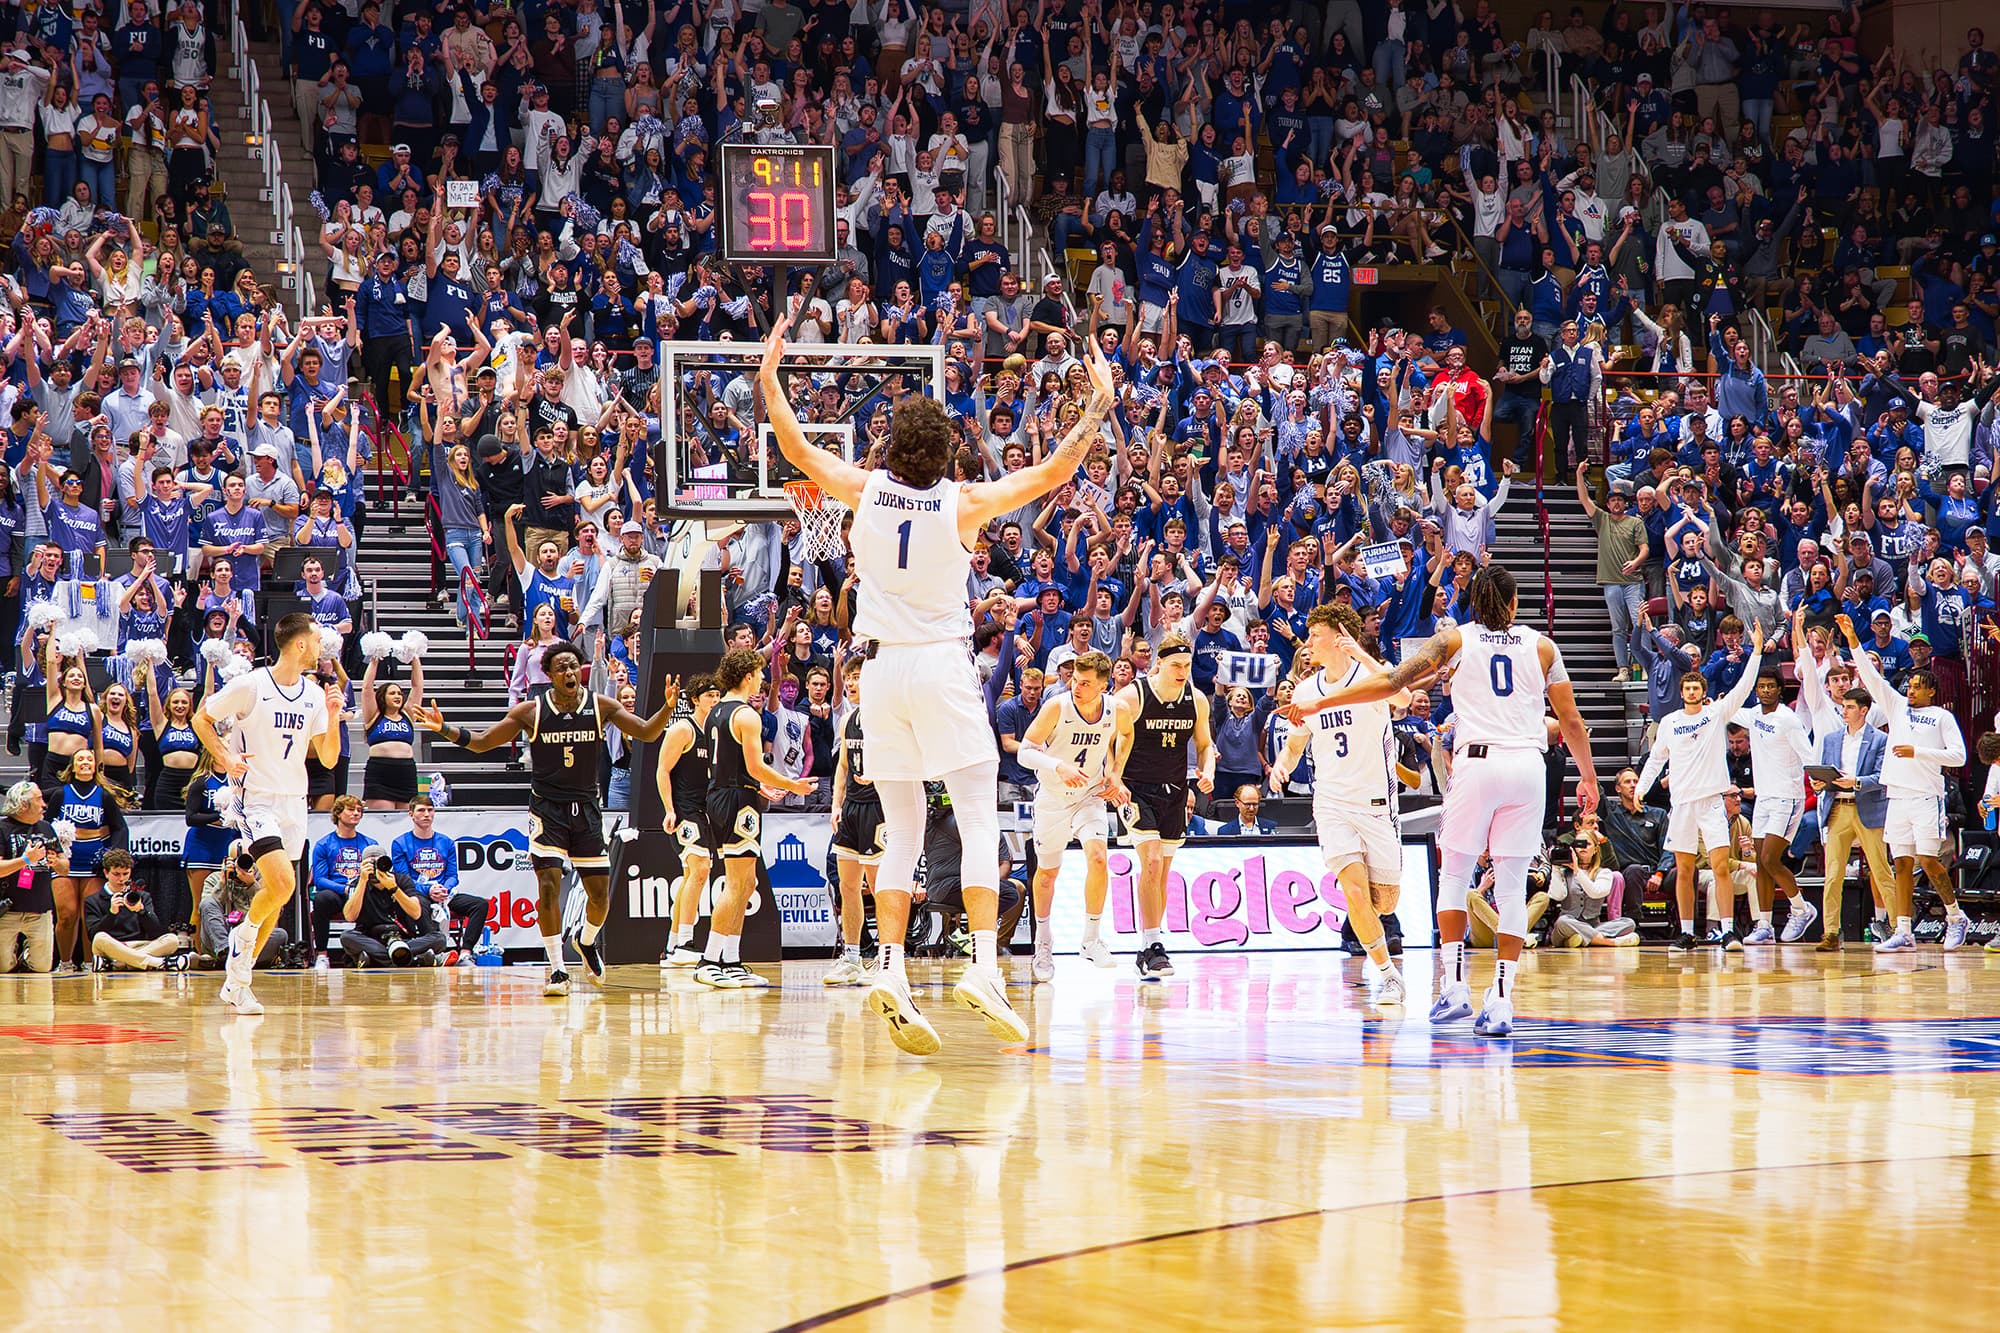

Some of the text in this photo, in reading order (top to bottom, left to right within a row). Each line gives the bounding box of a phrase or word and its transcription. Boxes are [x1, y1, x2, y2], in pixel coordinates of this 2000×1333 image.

[130, 31, 147, 43] FU
[308, 34, 325, 49] FU
[1277, 116, 1302, 130] FURMAN
[254, 149, 262, 159] G
[751, 148, 804, 156] DAKTRONICS
[753, 158, 819, 186] 9:11
[450, 182, 474, 191] G'DAY
[267, 191, 273, 201] F
[748, 192, 811, 247] 30
[277, 233, 284, 242] E
[289, 278, 296, 288] D
[1322, 269, 1341, 283] 25
[1357, 268, 1376, 284] EXIT
[1510, 346, 1533, 354] RYAN
[675, 499, 703, 507] SPALDING
[874, 490, 941, 513] JOHNSTON
[58, 513, 97, 532] Furman
[213, 521, 256, 538] Furman
[897, 520, 912, 570] 1
[1362, 543, 1399, 558] FURMAN
[1679, 561, 1702, 579] FU
[1480, 632, 1507, 645] SMITH
[1230, 655, 1266, 683] FU
[1491, 654, 1514, 697] 0
[62, 709, 87, 725] DINS
[274, 713, 304, 730] DINS
[1145, 719, 1194, 731] WOFFORD
[1320, 709, 1352, 730] DINS
[384, 720, 408, 733] DINS
[106, 730, 130, 747] DINS
[170, 731, 194, 743] DINS
[541, 731, 596, 744] WOFFORD
[1071, 733, 1101, 745] DINS
[1335, 732, 1349, 758] 3
[282, 734, 294, 760] 7
[563, 746, 575, 768] 5
[1075, 749, 1088, 769] 4
[130, 837, 181, 854] utions
[457, 840, 514, 871] DC
[781, 894, 809, 908] CITY
[1108, 853, 1348, 946] ingles
[779, 909, 829, 923] EVILLE
[192, 1106, 514, 1167] CENTER
[381, 1101, 738, 1160] CHEROKEE
[23, 1112, 295, 1174] ASHEVILLE
